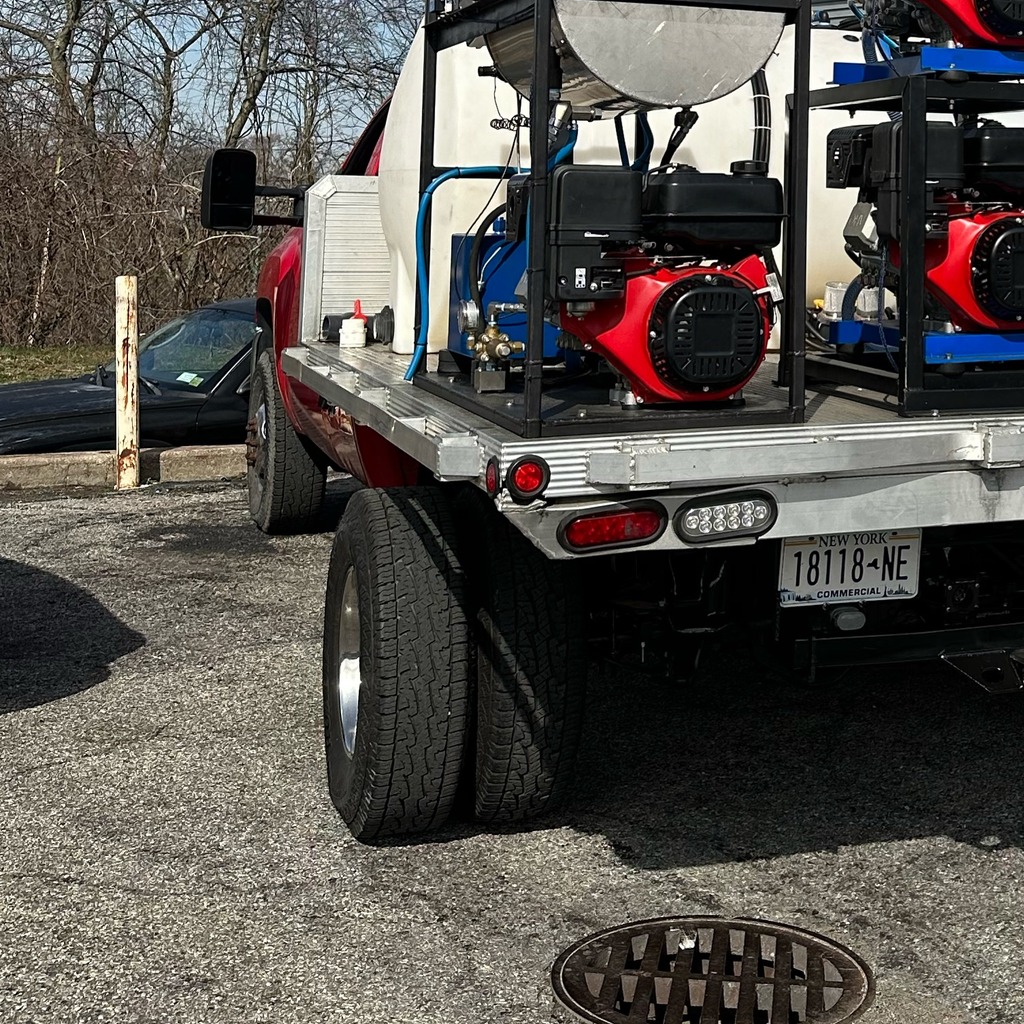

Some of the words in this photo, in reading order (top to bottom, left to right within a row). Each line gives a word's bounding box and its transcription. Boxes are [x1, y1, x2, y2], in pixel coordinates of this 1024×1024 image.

[819, 534, 850, 547] NEW
[853, 532, 888, 545] YORK
[794, 547, 865, 587] 18118
[881, 545, 911, 581] NE
[816, 587, 881, 599] COMMERCIAL
